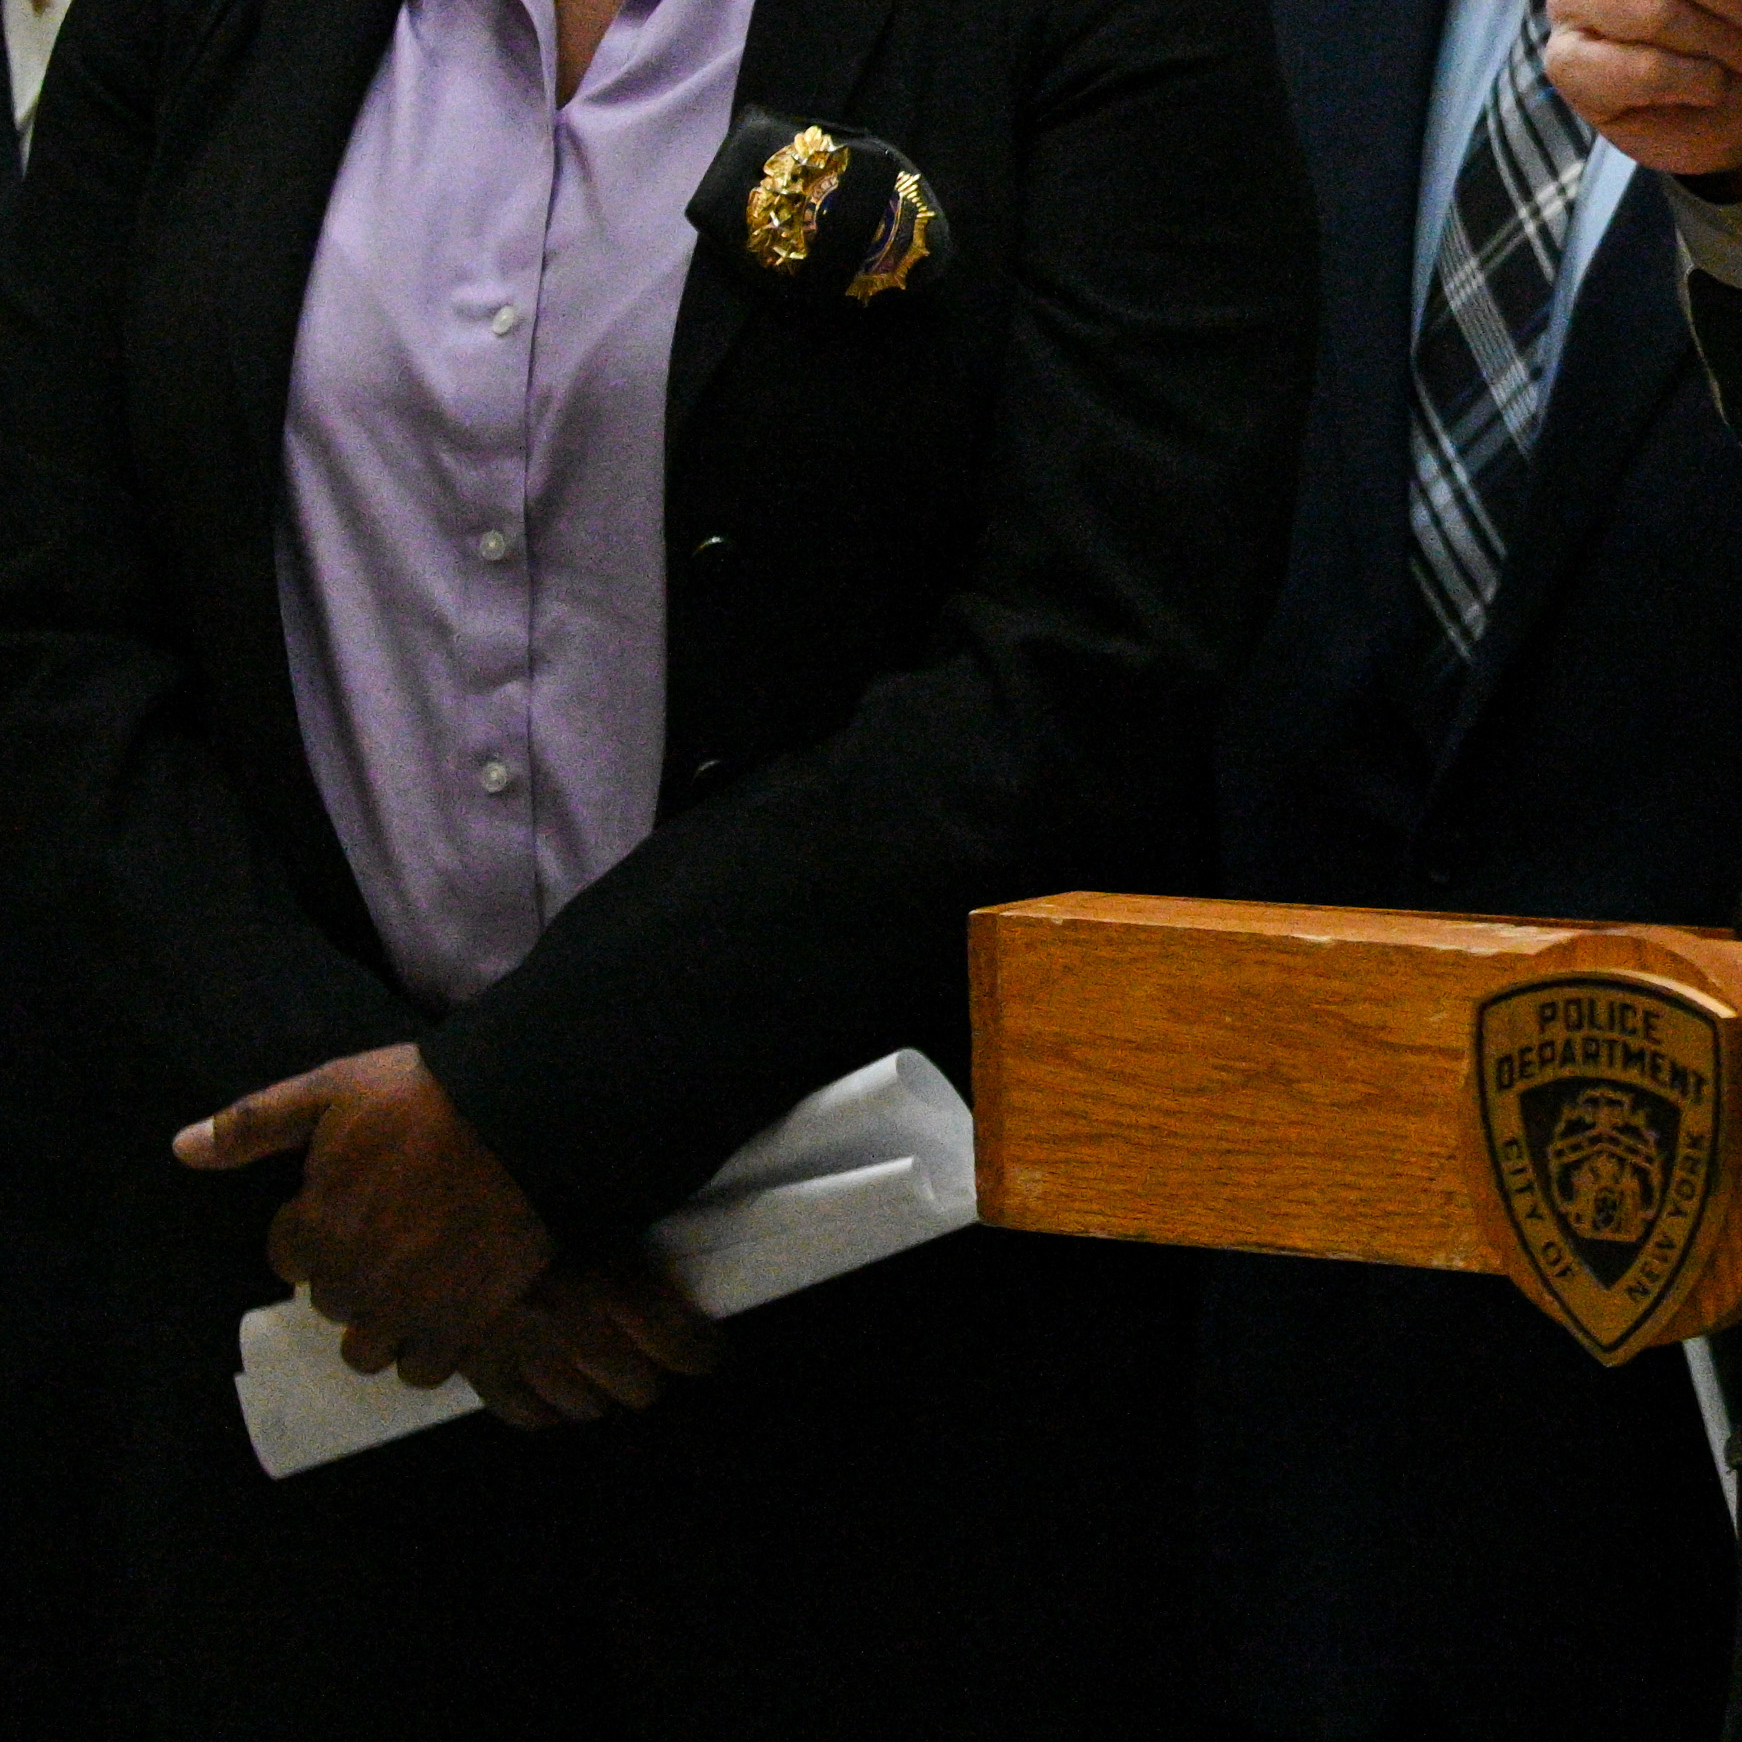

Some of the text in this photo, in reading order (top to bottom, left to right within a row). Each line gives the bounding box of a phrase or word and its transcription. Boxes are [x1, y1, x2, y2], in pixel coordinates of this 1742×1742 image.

[1538, 998, 1662, 1044] POLICE
[1496, 1036, 1706, 1105] DEPARTMENT
[1501, 1136, 1543, 1222] CITY
[1666, 1134, 1706, 1220] YORK
